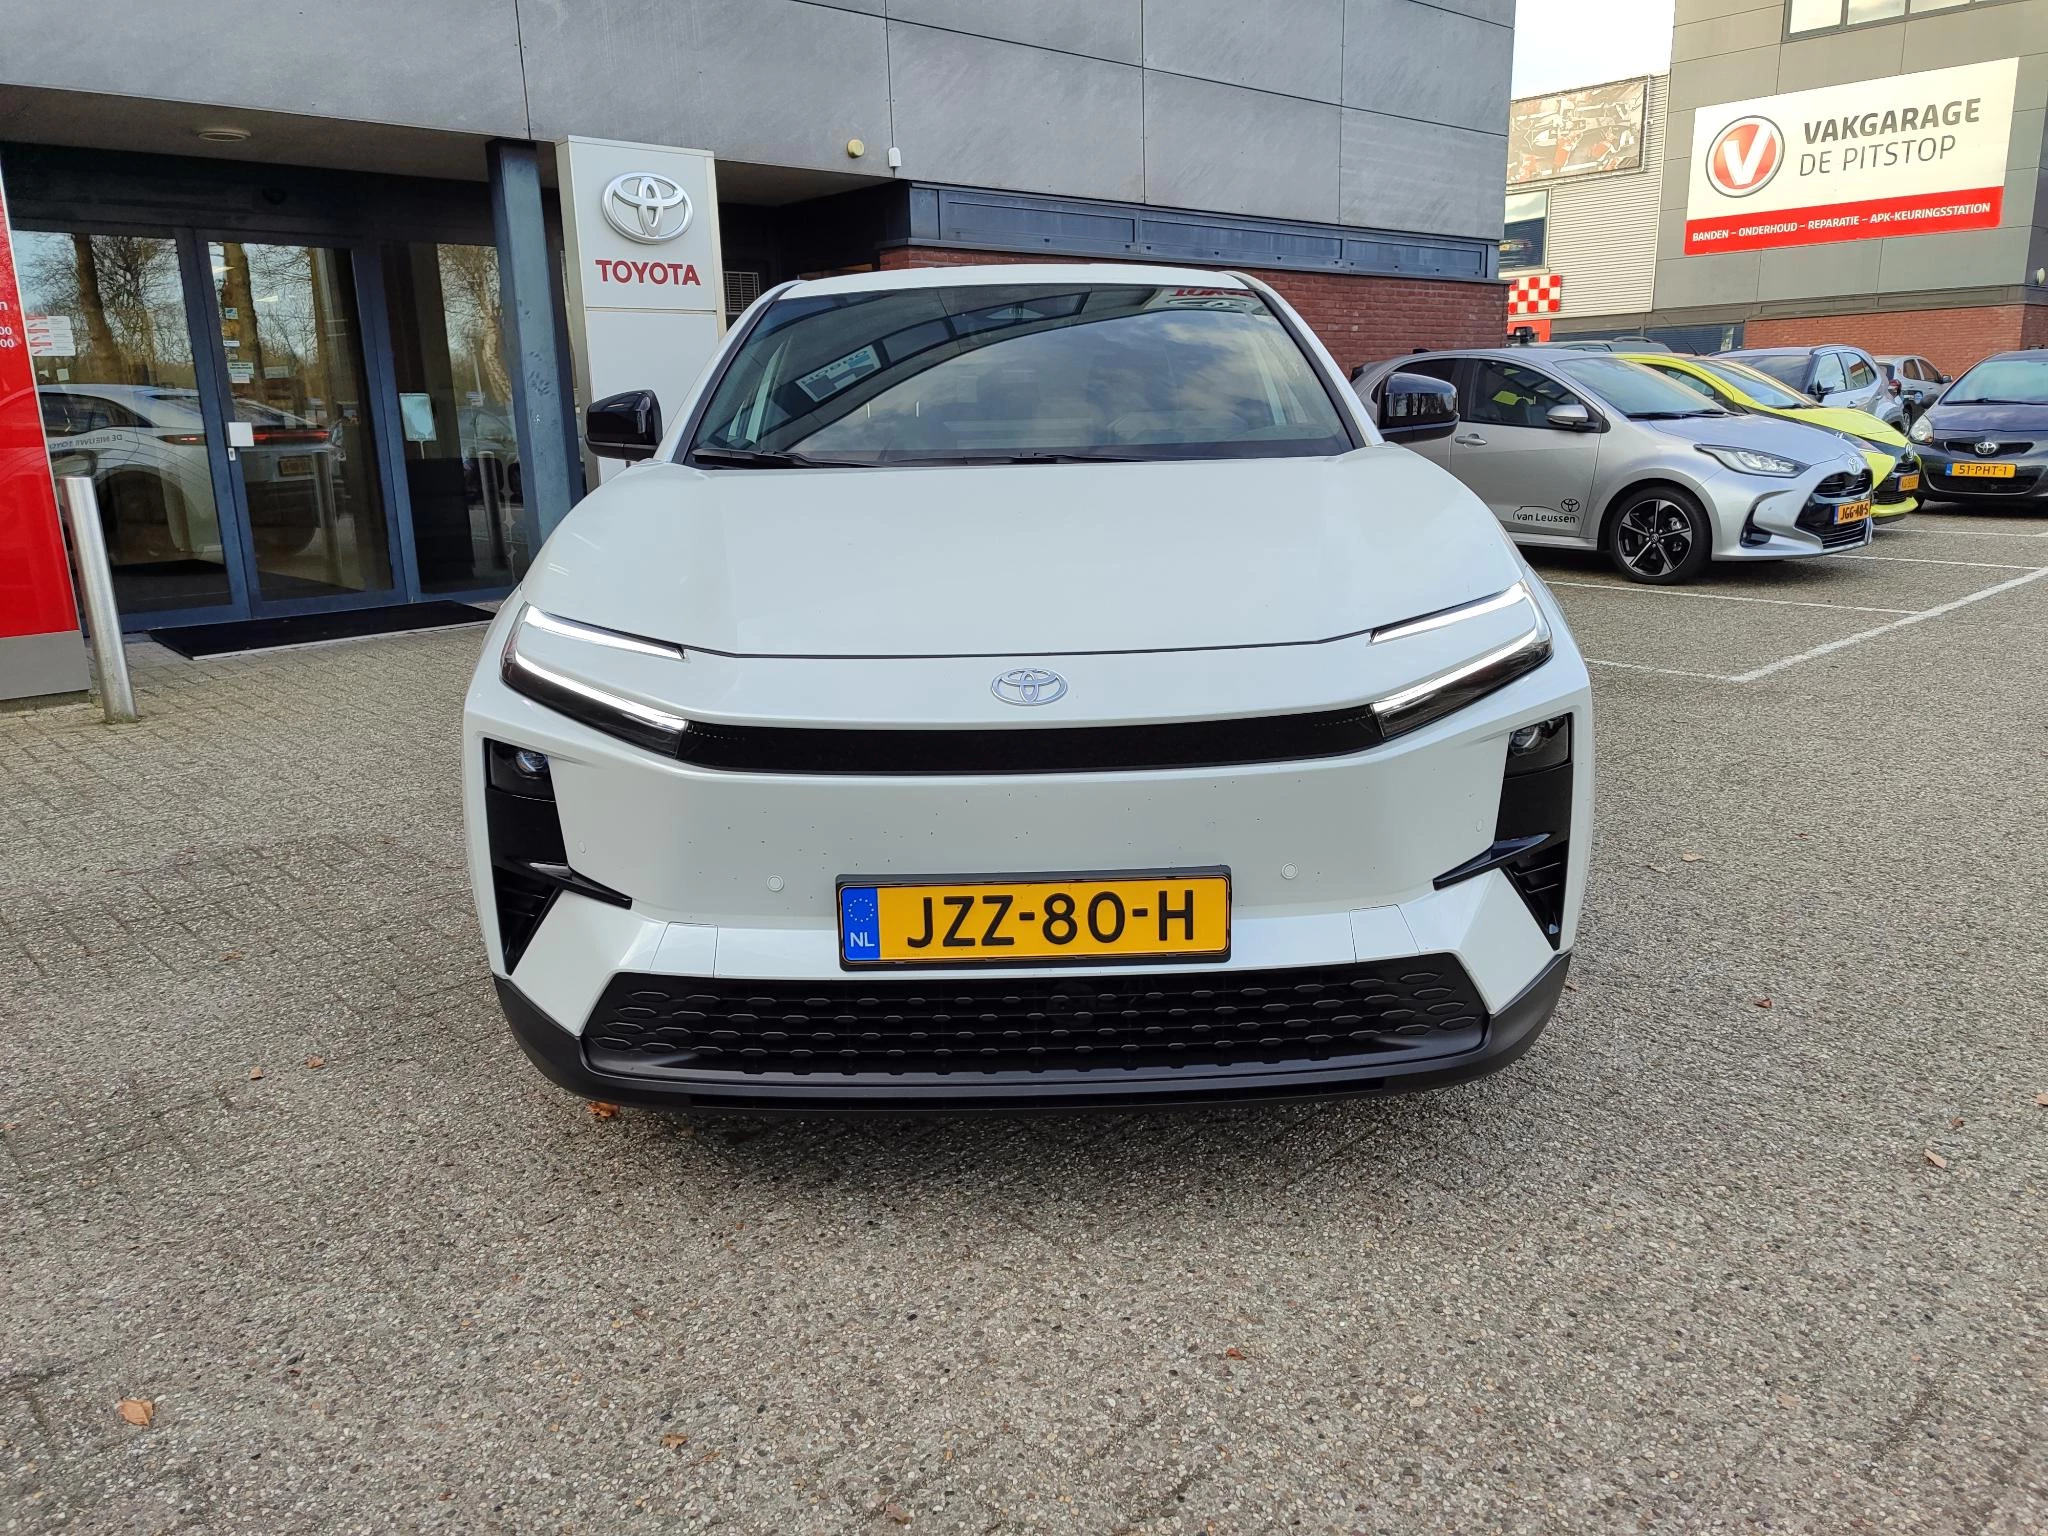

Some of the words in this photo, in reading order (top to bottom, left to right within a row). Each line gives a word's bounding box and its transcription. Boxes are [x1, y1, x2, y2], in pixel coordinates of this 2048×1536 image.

[1804, 98, 1981, 144] VAKGARAGE
[1799, 151, 1832, 176] DE
[1843, 135, 1956, 171] PITSTOP
[1692, 229, 1729, 242] BANDEN
[1738, 222, 1798, 237] ONDERHOUD
[1808, 216, 1860, 230] REPARATIE
[1870, 202, 1991, 224] APK-KEURINGSSTATION
[595, 259, 701, 286] TOYOTA
[1958, 465, 2007, 475] 51-PHT-1
[1517, 513, 1533, 521] van
[1536, 513, 1576, 523] Leussen
[850, 931, 875, 948] NL
[907, 889, 1194, 949] JZZ-80-H
